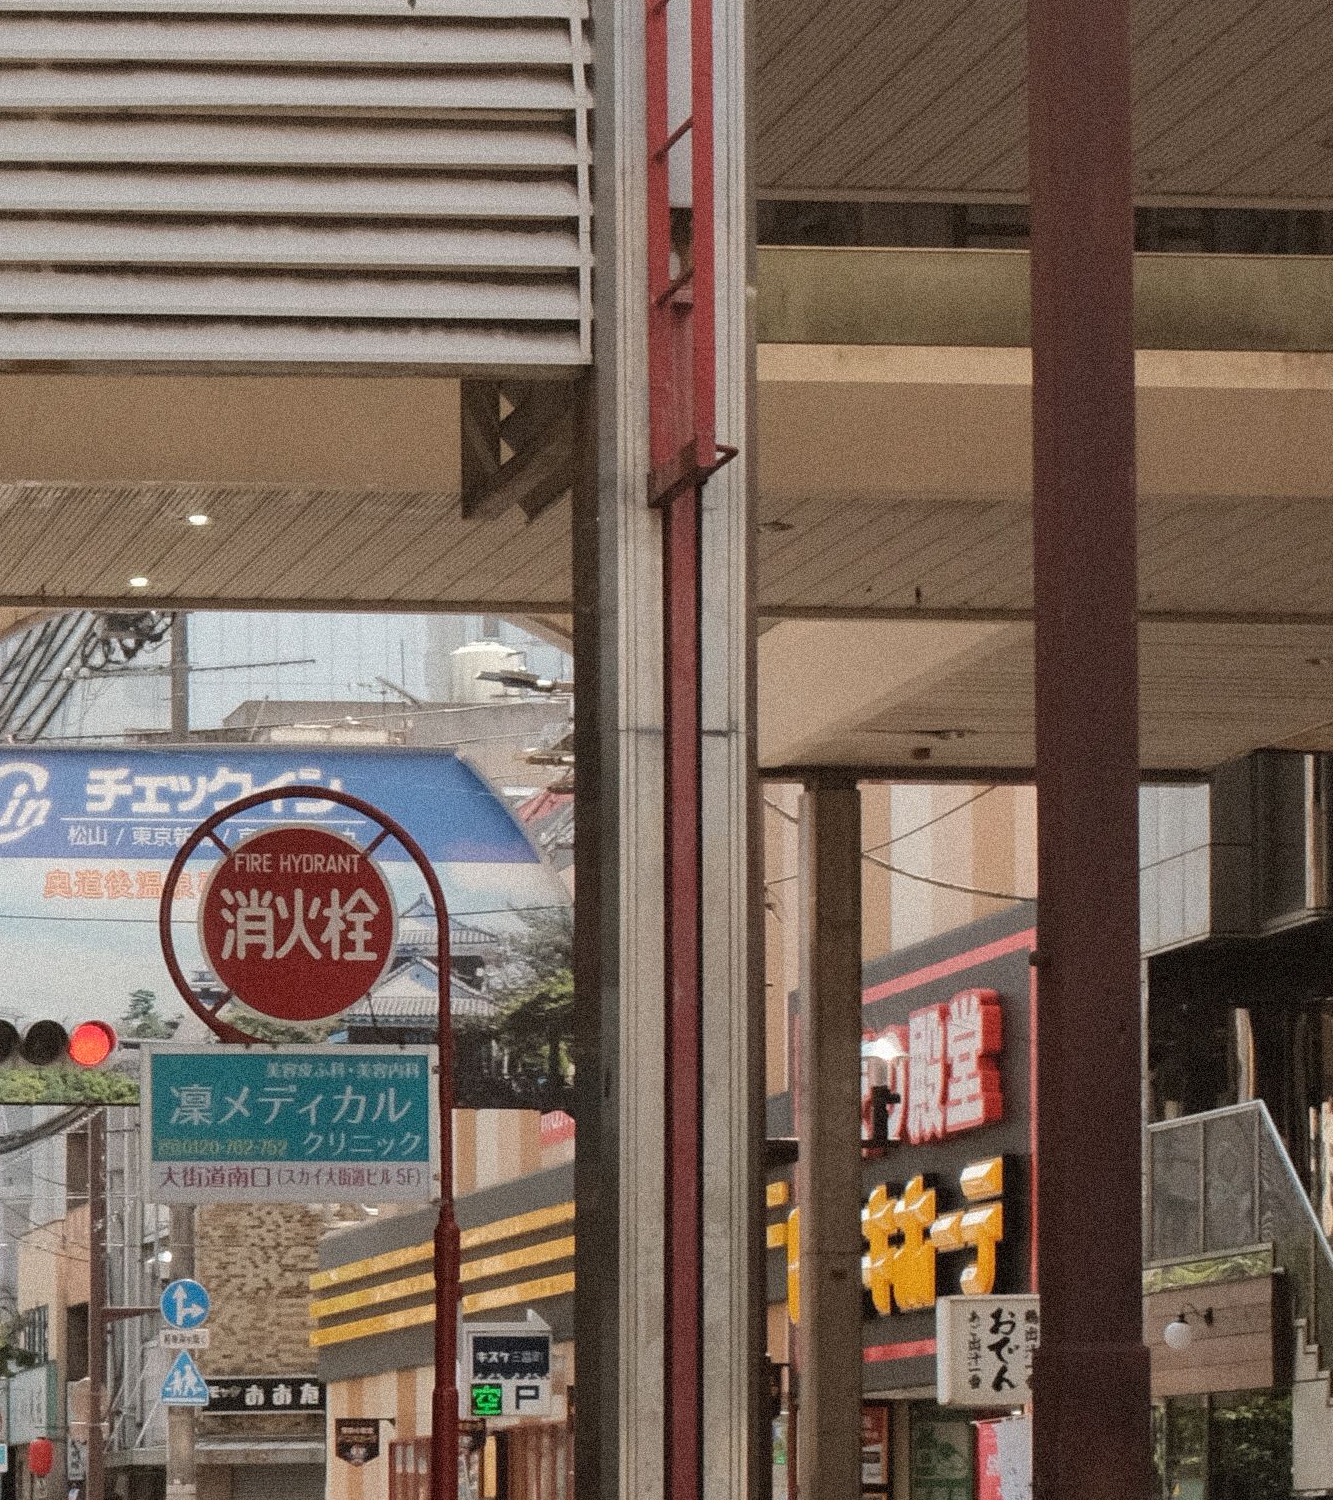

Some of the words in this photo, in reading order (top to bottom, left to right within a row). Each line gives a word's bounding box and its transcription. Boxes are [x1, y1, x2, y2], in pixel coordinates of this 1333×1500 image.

[85, 766, 344, 815] チェックイン
[68, 825, 108, 847] 松山
[234, 853, 273, 873] FIRE
[279, 853, 361, 874] HYDRANT
[219, 887, 381, 961] 消火栓
[302, 1131, 422, 1156] クリニック
[159, 1166, 271, 1189] 大街道南口
[987, 1307, 1017, 1392] おでん
[471, 1384, 502, 1415] 空
[515, 1385, 540, 1410] P
